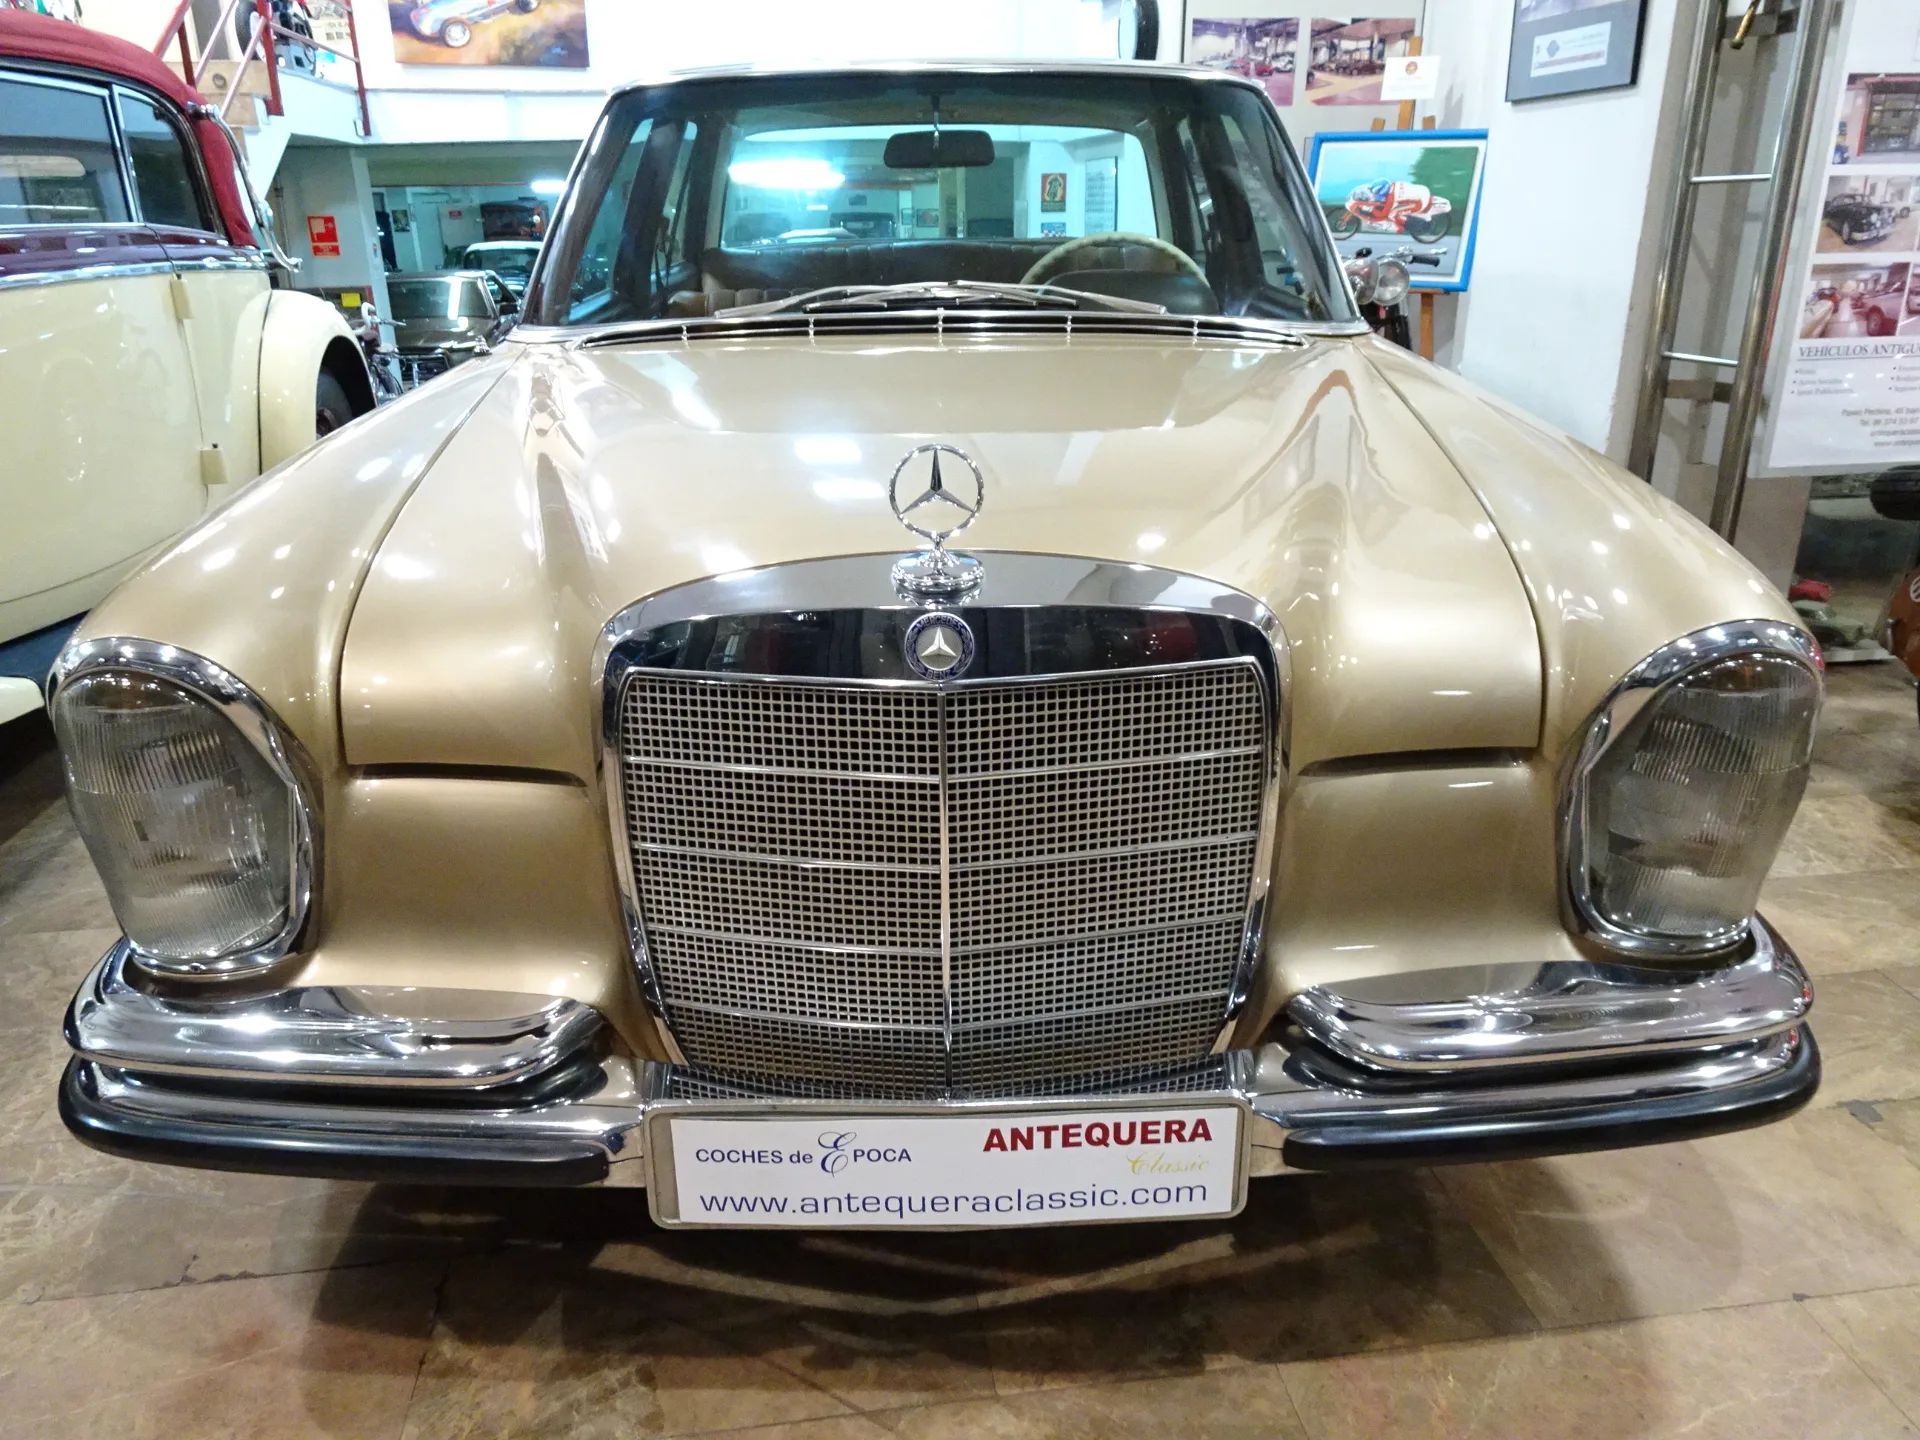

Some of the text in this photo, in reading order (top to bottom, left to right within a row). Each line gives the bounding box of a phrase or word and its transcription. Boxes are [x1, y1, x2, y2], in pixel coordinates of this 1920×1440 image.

[916, 615, 964, 630] MERCEDES
[926, 669, 952, 680] BENZ
[983, 1118, 1212, 1152] ANTEQUERA
[695, 1148, 783, 1164] COCHES
[789, 1149, 813, 1164] de
[1126, 1151, 1210, 1175] Classic
[700, 1184, 1207, 1218] www.antequeraclassic.com
